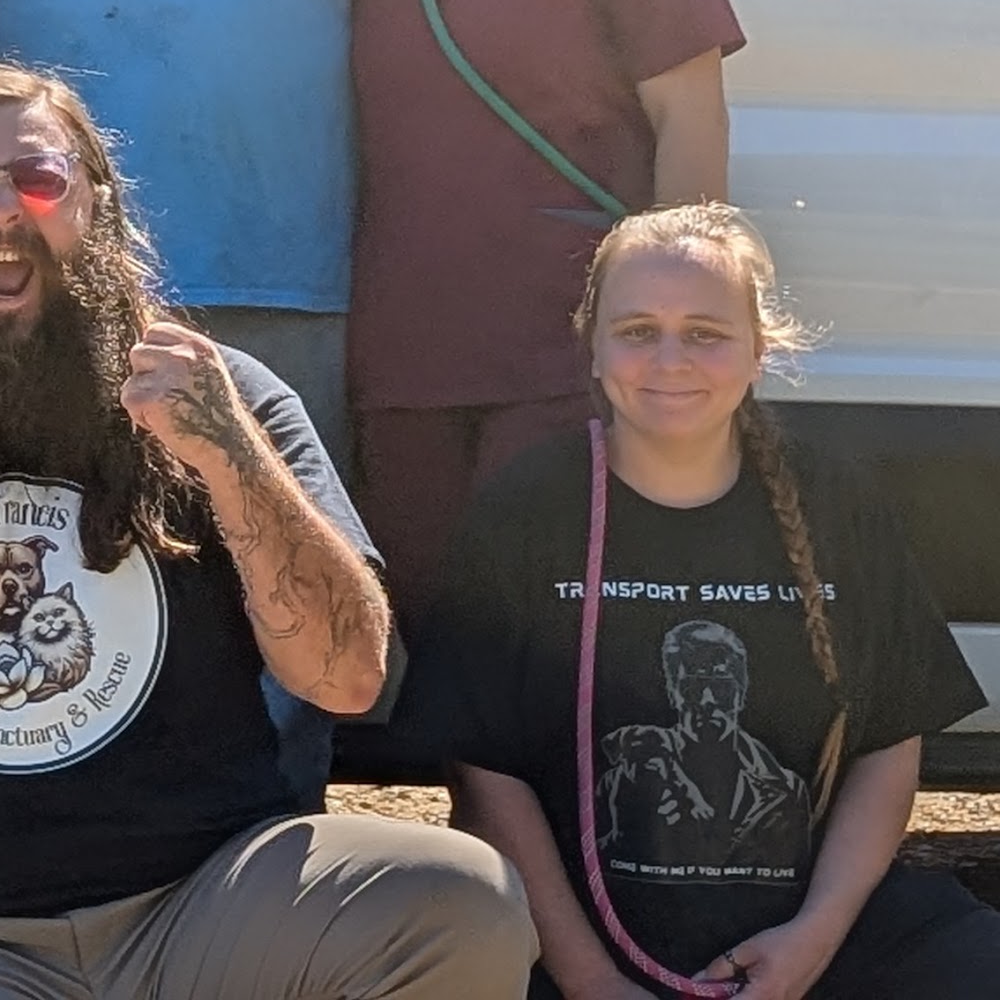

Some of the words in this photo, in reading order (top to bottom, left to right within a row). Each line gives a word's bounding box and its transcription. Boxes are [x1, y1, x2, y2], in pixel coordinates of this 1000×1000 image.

[554, 581, 690, 602] TRNSPORT
[699, 583, 771, 602] SAVES
[66, 703, 89, 728] &
[82, 651, 132, 712] Rescue
[610, 859, 636, 873] COME
[640, 865, 668, 875] WITH
[698, 866, 721, 876] YOU
[723, 867, 753, 877] WANT
[756, 868, 771, 877] TO
